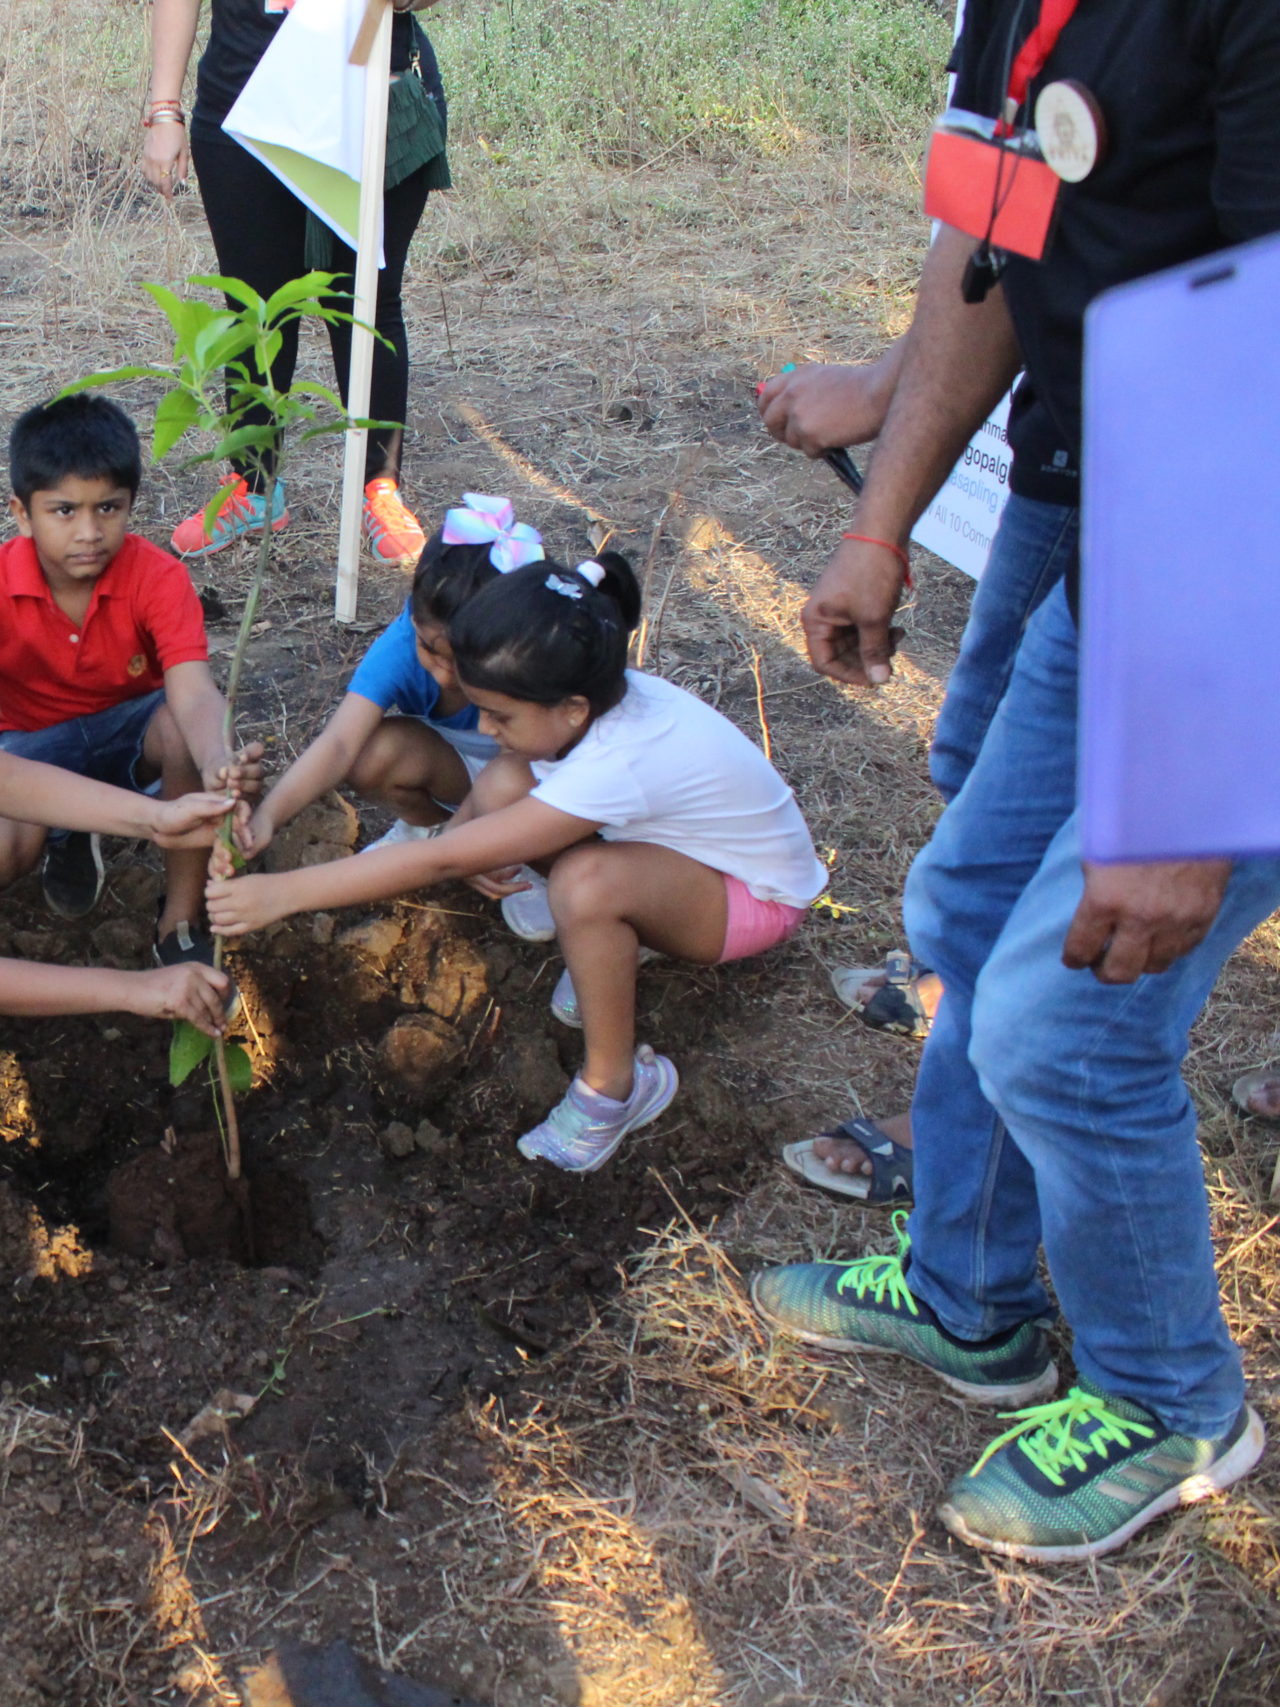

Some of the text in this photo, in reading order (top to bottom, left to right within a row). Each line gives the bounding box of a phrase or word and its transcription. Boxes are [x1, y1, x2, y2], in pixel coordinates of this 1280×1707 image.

[964, 445, 1012, 485] gopalg
[934, 504, 948, 525] All
[950, 512, 961, 532] 10
